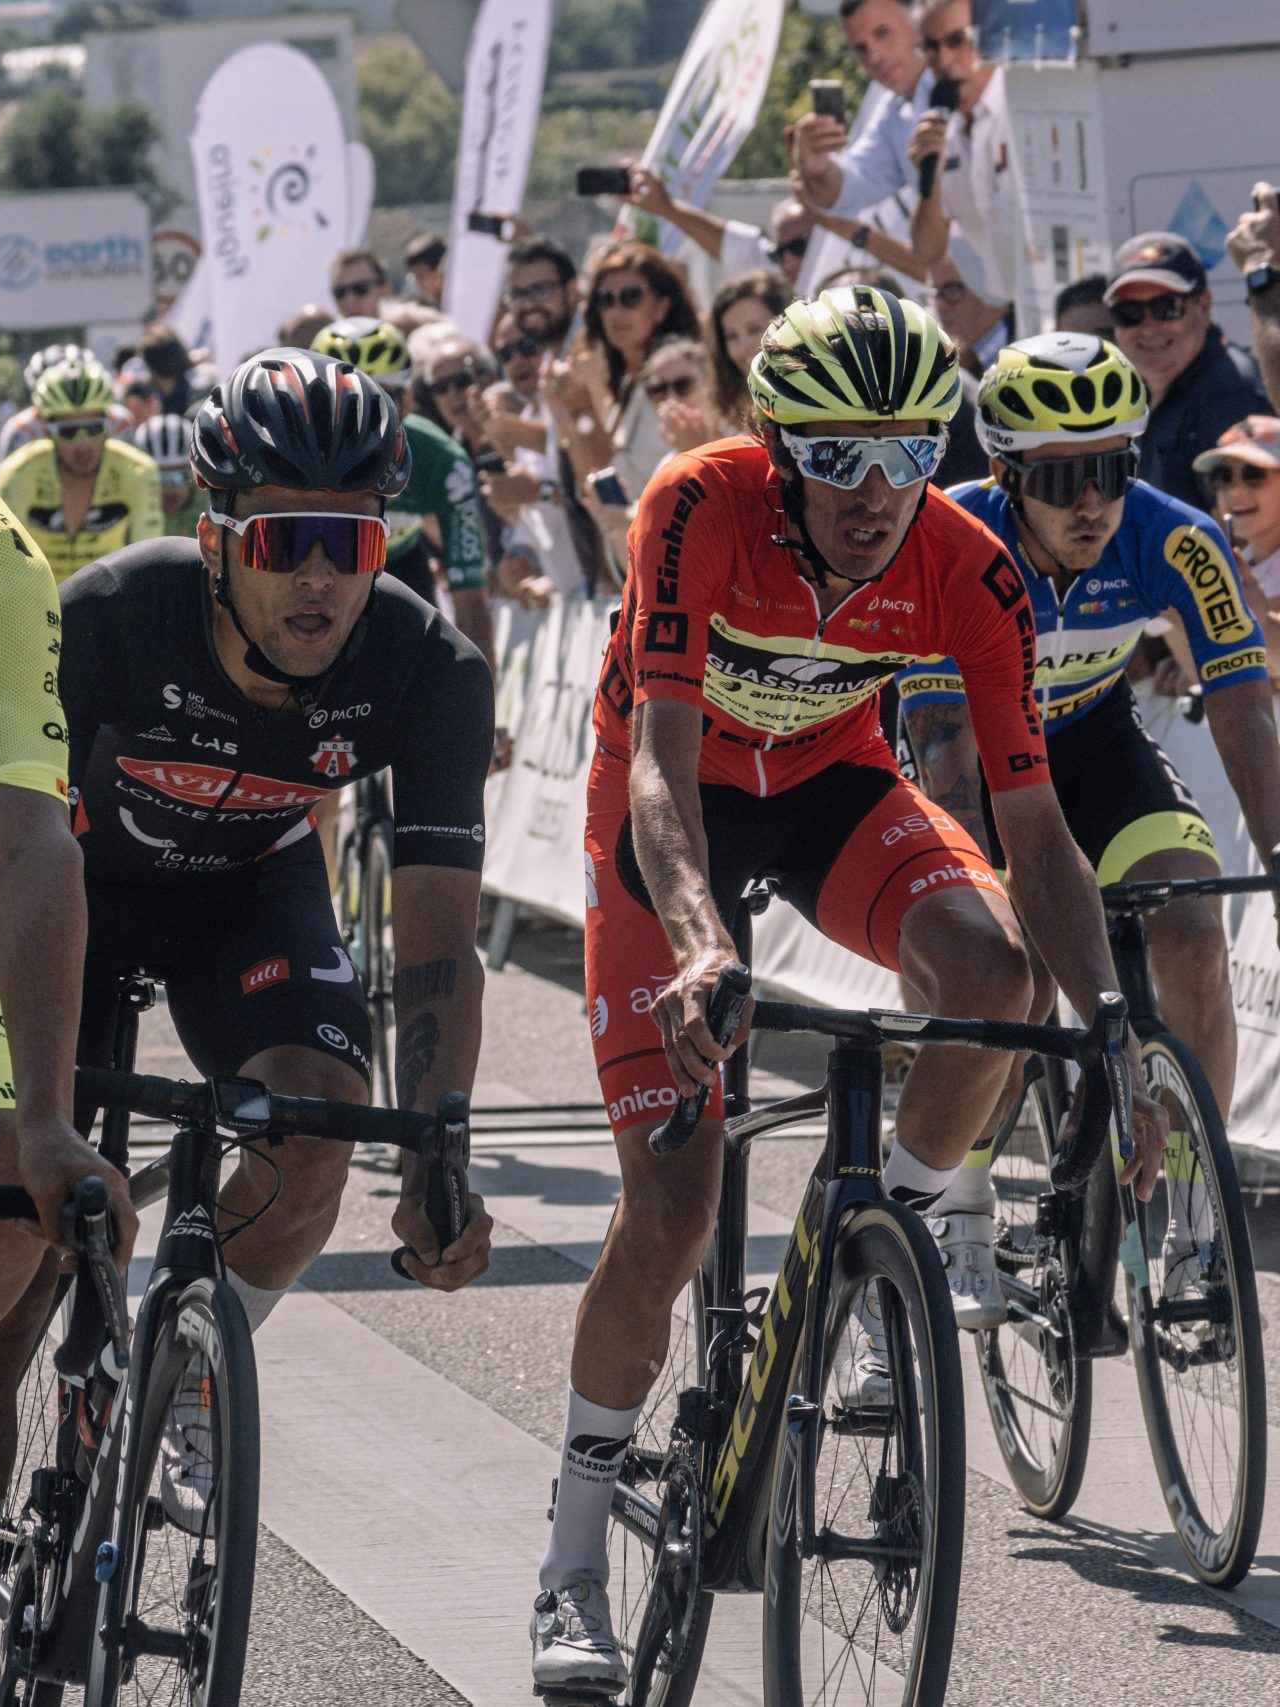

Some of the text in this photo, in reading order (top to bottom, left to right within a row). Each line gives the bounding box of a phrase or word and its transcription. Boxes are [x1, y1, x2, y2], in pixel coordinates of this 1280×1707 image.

[44, 235, 143, 265] earth
[238, 453, 263, 484] LAS
[655, 477, 708, 605] Einhell
[882, 599, 914, 613] PACTO
[706, 653, 880, 695] GLASSDRIVE
[187, 691, 204, 704] UCI
[750, 690, 827, 708] anicolor
[185, 707, 206, 719] TEAM
[186, 700, 239, 725] CONTINENTAL
[330, 703, 371, 722] PACTO
[191, 733, 238, 755] LAS
[115, 780, 305, 822] LOULETANO
[893, 1017, 922, 1025] GARMIN
[228, 1120, 258, 1129] GARMIN
